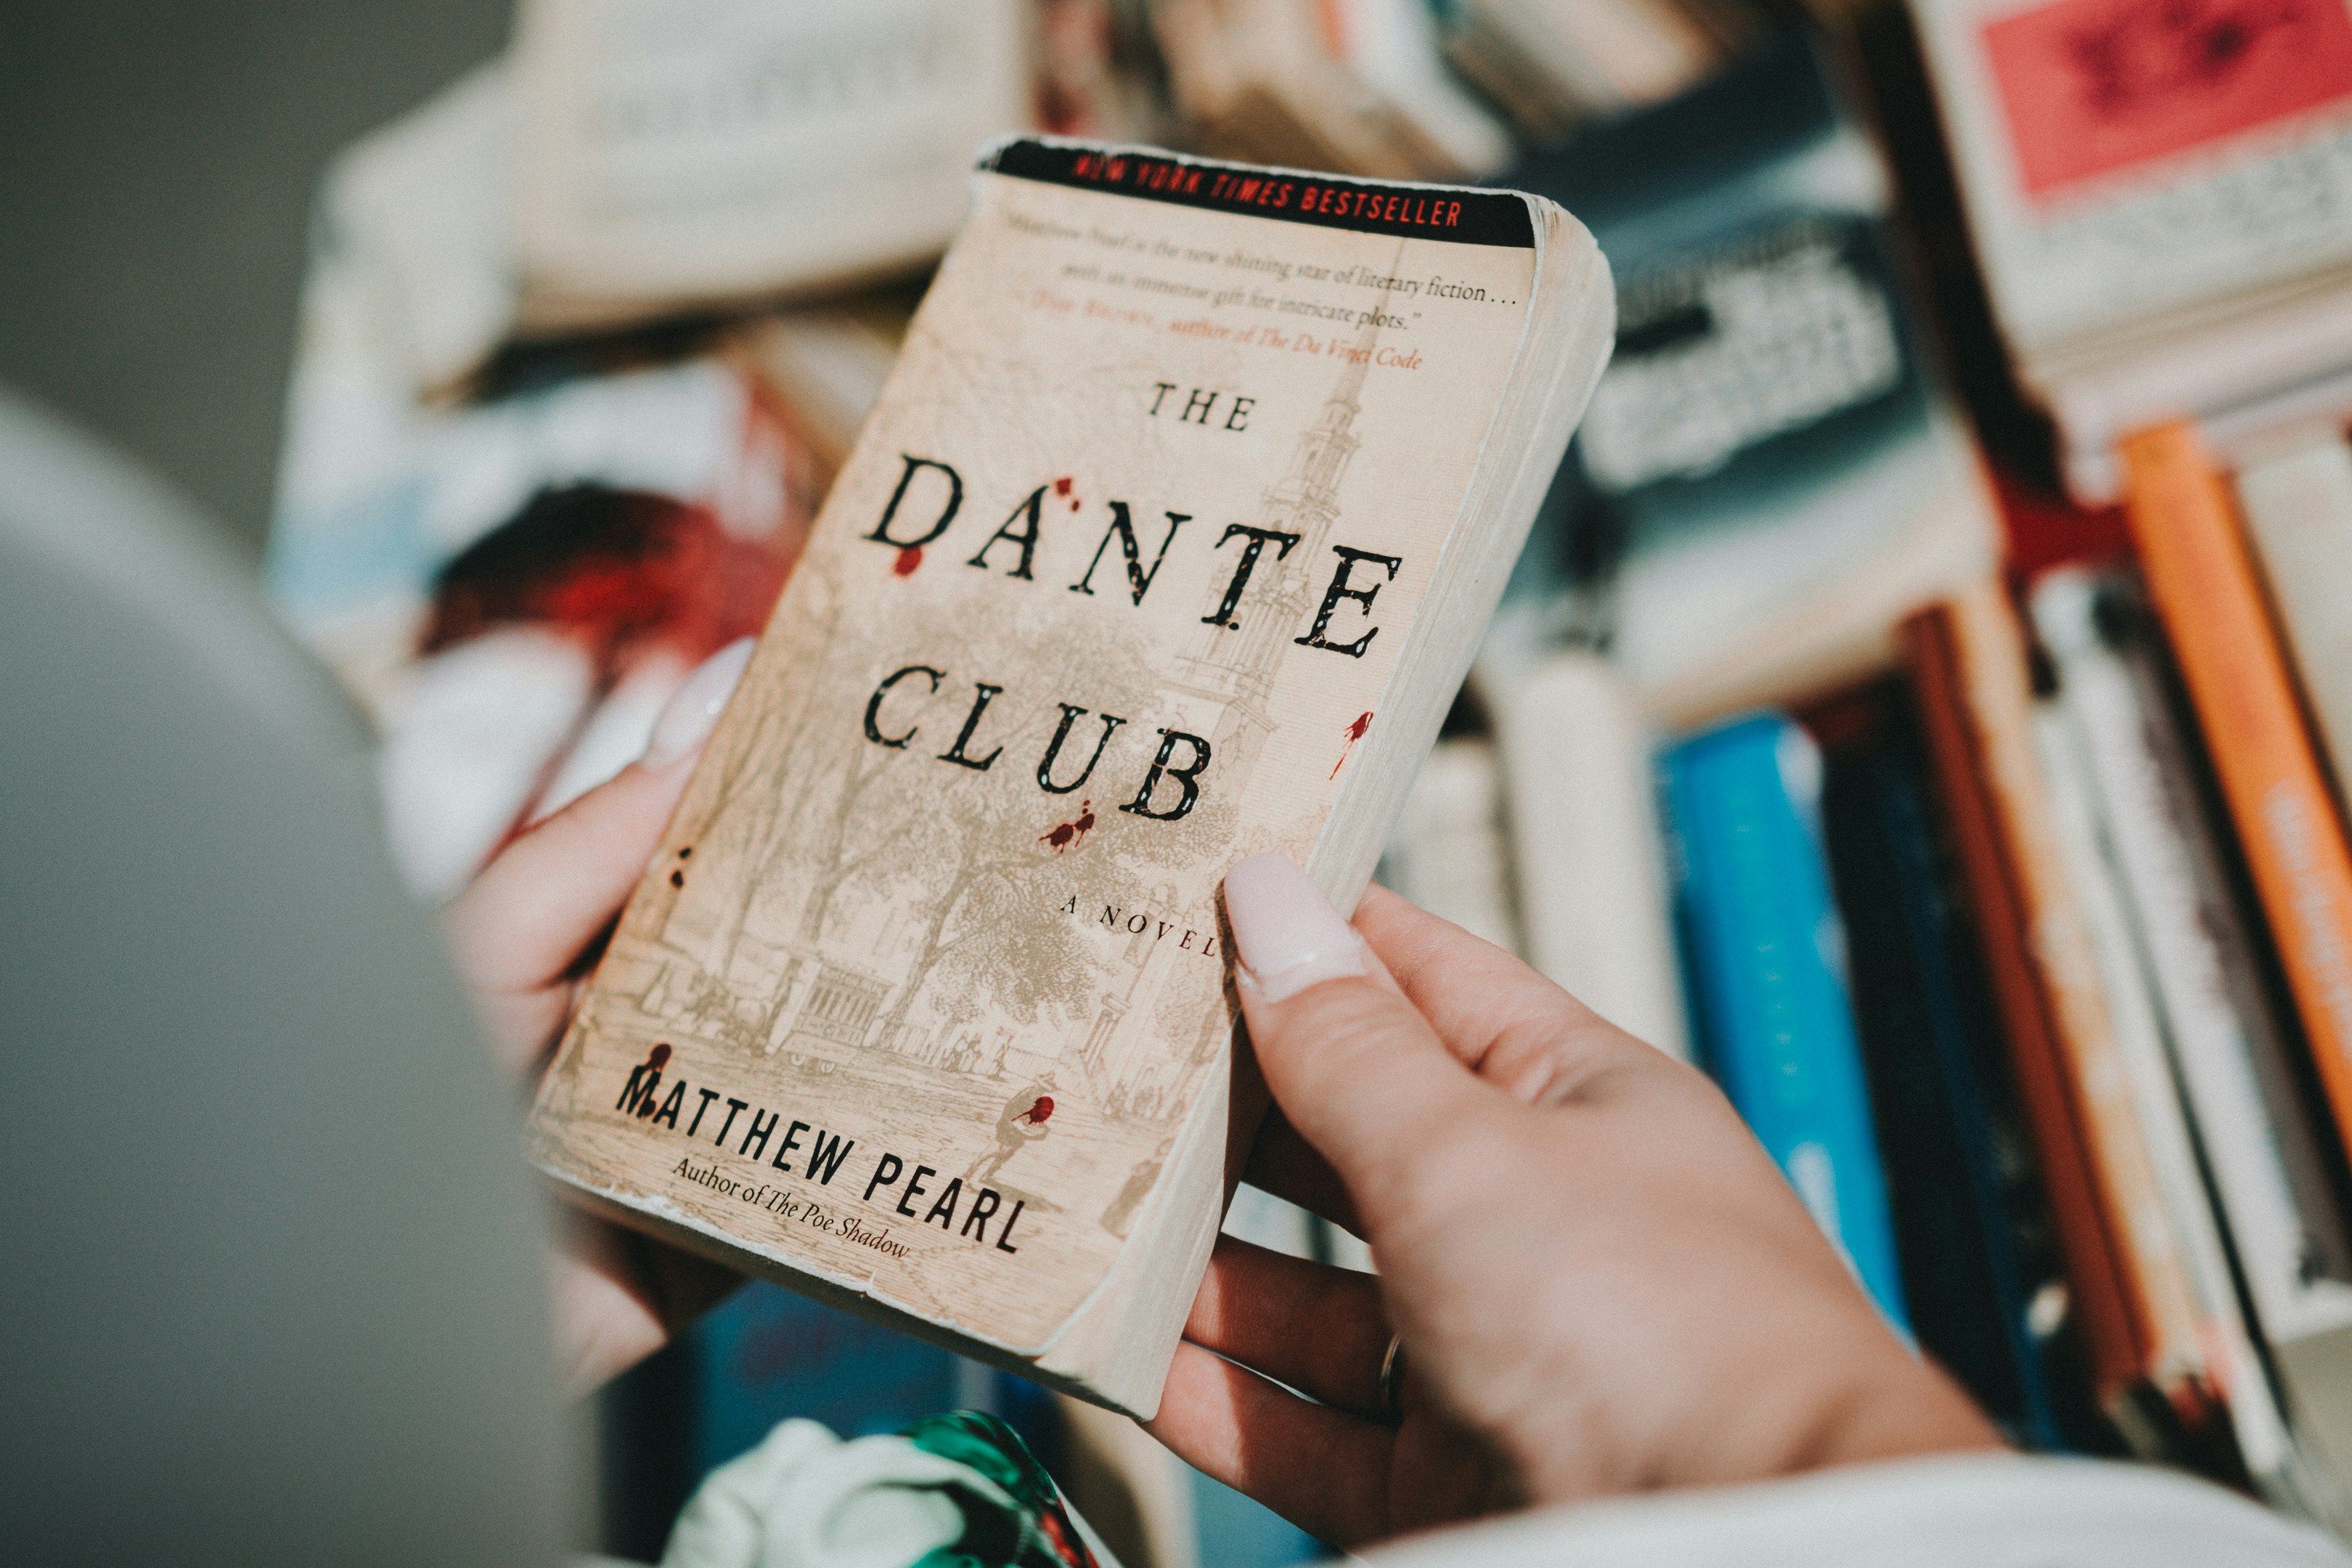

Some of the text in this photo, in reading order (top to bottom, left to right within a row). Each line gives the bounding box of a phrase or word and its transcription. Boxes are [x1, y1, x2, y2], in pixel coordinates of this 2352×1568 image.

[1136, 163, 1202, 194] YORK
[1210, 174, 1293, 207] TIMES
[1301, 186, 1461, 227] BESTSELLER
[1224, 249, 1289, 282] shining
[1298, 263, 1330, 281] star
[1333, 265, 1360, 285] of
[1356, 266, 1423, 298] literary
[1278, 298, 1355, 323] intricate
[1257, 330, 1291, 350] The
[1290, 333, 1323, 355] Da
[1376, 346, 1424, 369] Code
[1148, 382, 1257, 433] THE
[860, 453, 1403, 658] DANTE
[863, 665, 1212, 821] CLUB
[1060, 894, 1217, 957] A NOVEL
[616, 1064, 1026, 1254] MATTHEW PEARL
[672, 1157, 910, 1258] Author of The Poe Shadow
